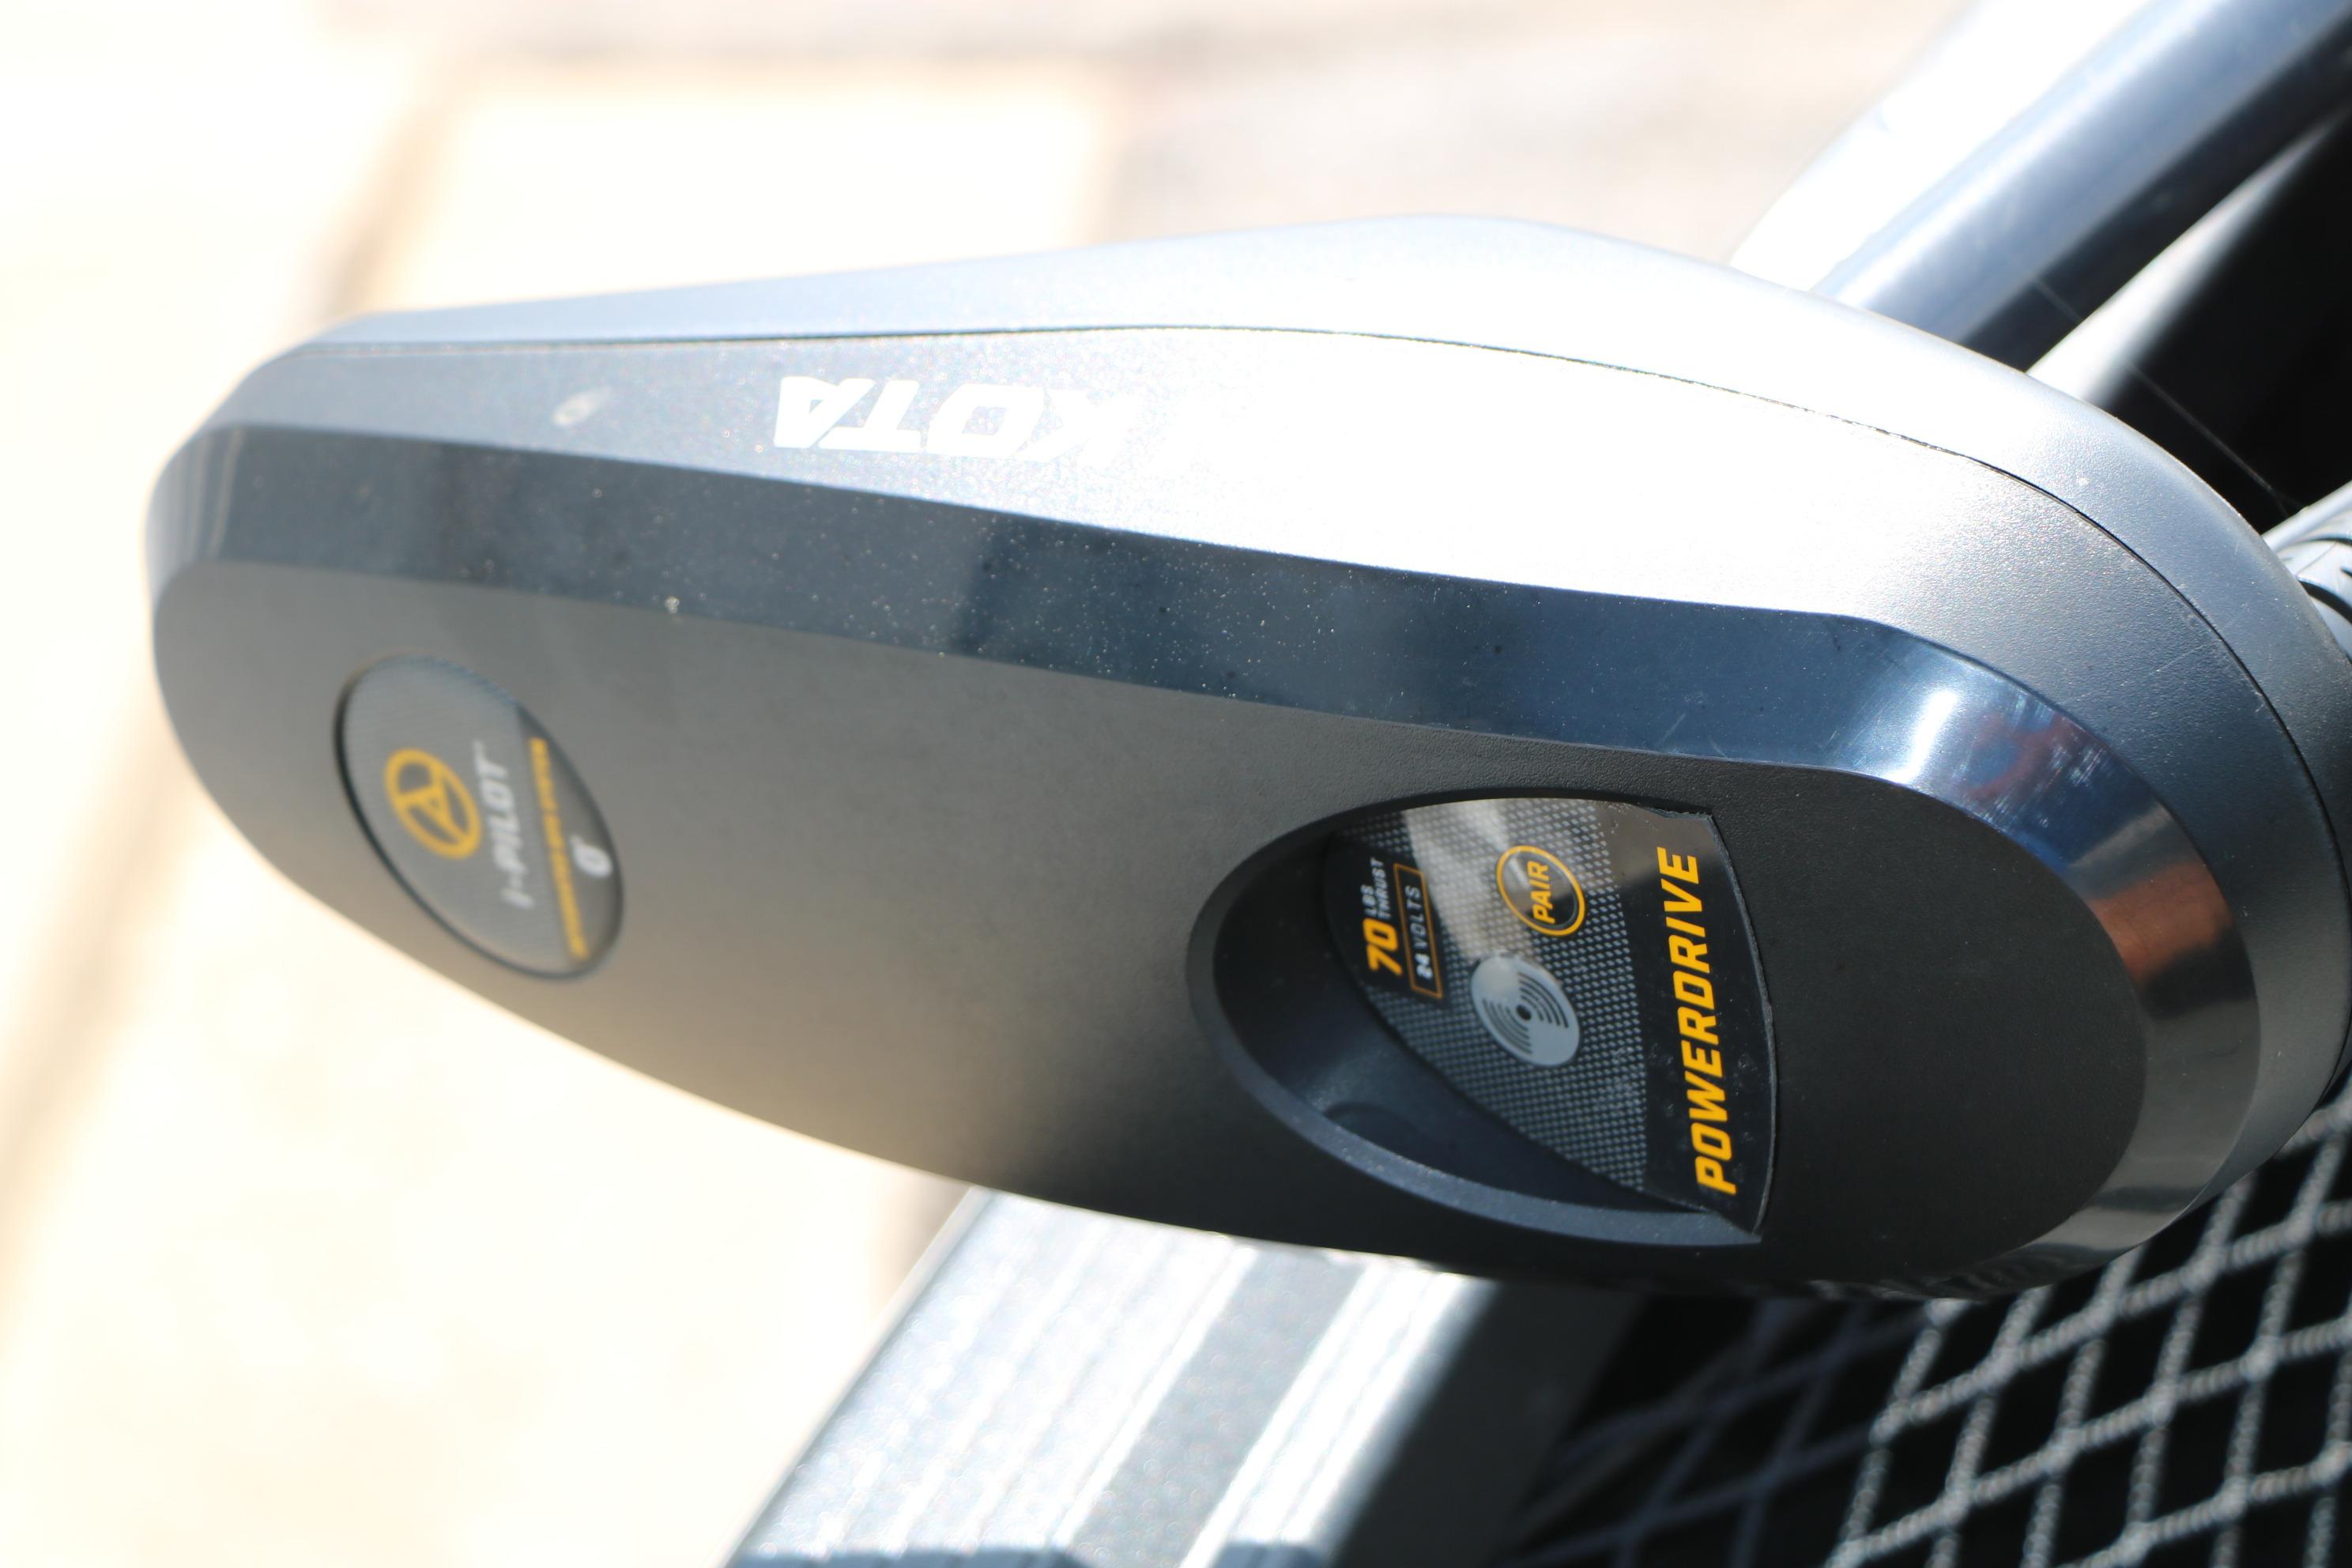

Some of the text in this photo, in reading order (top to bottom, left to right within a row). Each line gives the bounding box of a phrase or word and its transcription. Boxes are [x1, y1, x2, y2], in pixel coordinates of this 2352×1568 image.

[774, 375, 1130, 465] KOTA
[1360, 884, 1378, 917] LBS
[1370, 857, 1392, 919] THRUST
[1527, 861, 1555, 924] PAIR
[1363, 918, 1403, 976] 70
[1404, 884, 1434, 980] 24 VOLTS
[1657, 846, 1737, 1195] POWERDRIVE
